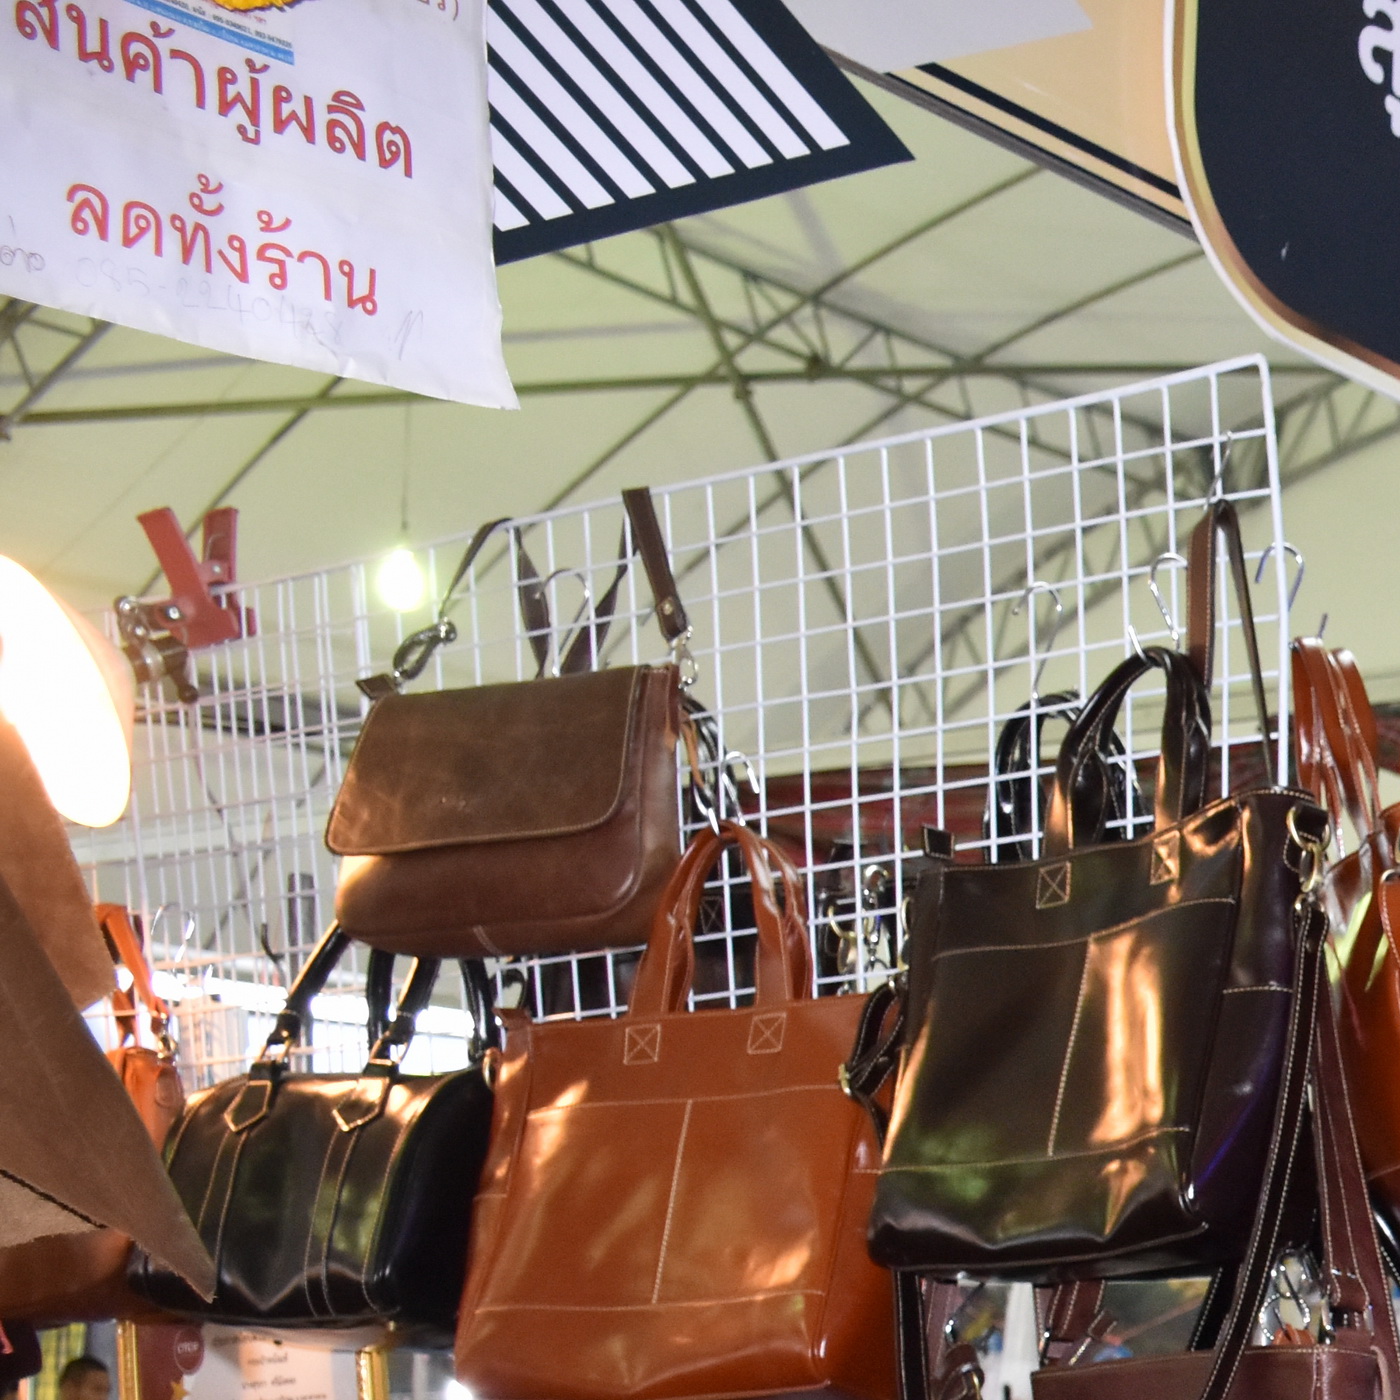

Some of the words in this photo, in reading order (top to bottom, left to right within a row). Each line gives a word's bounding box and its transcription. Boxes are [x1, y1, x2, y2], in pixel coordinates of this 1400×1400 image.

[15, 0, 415, 179] สนค้าผู้ผลิต
[66, 172, 380, 316] ลดทั้งร้าน
